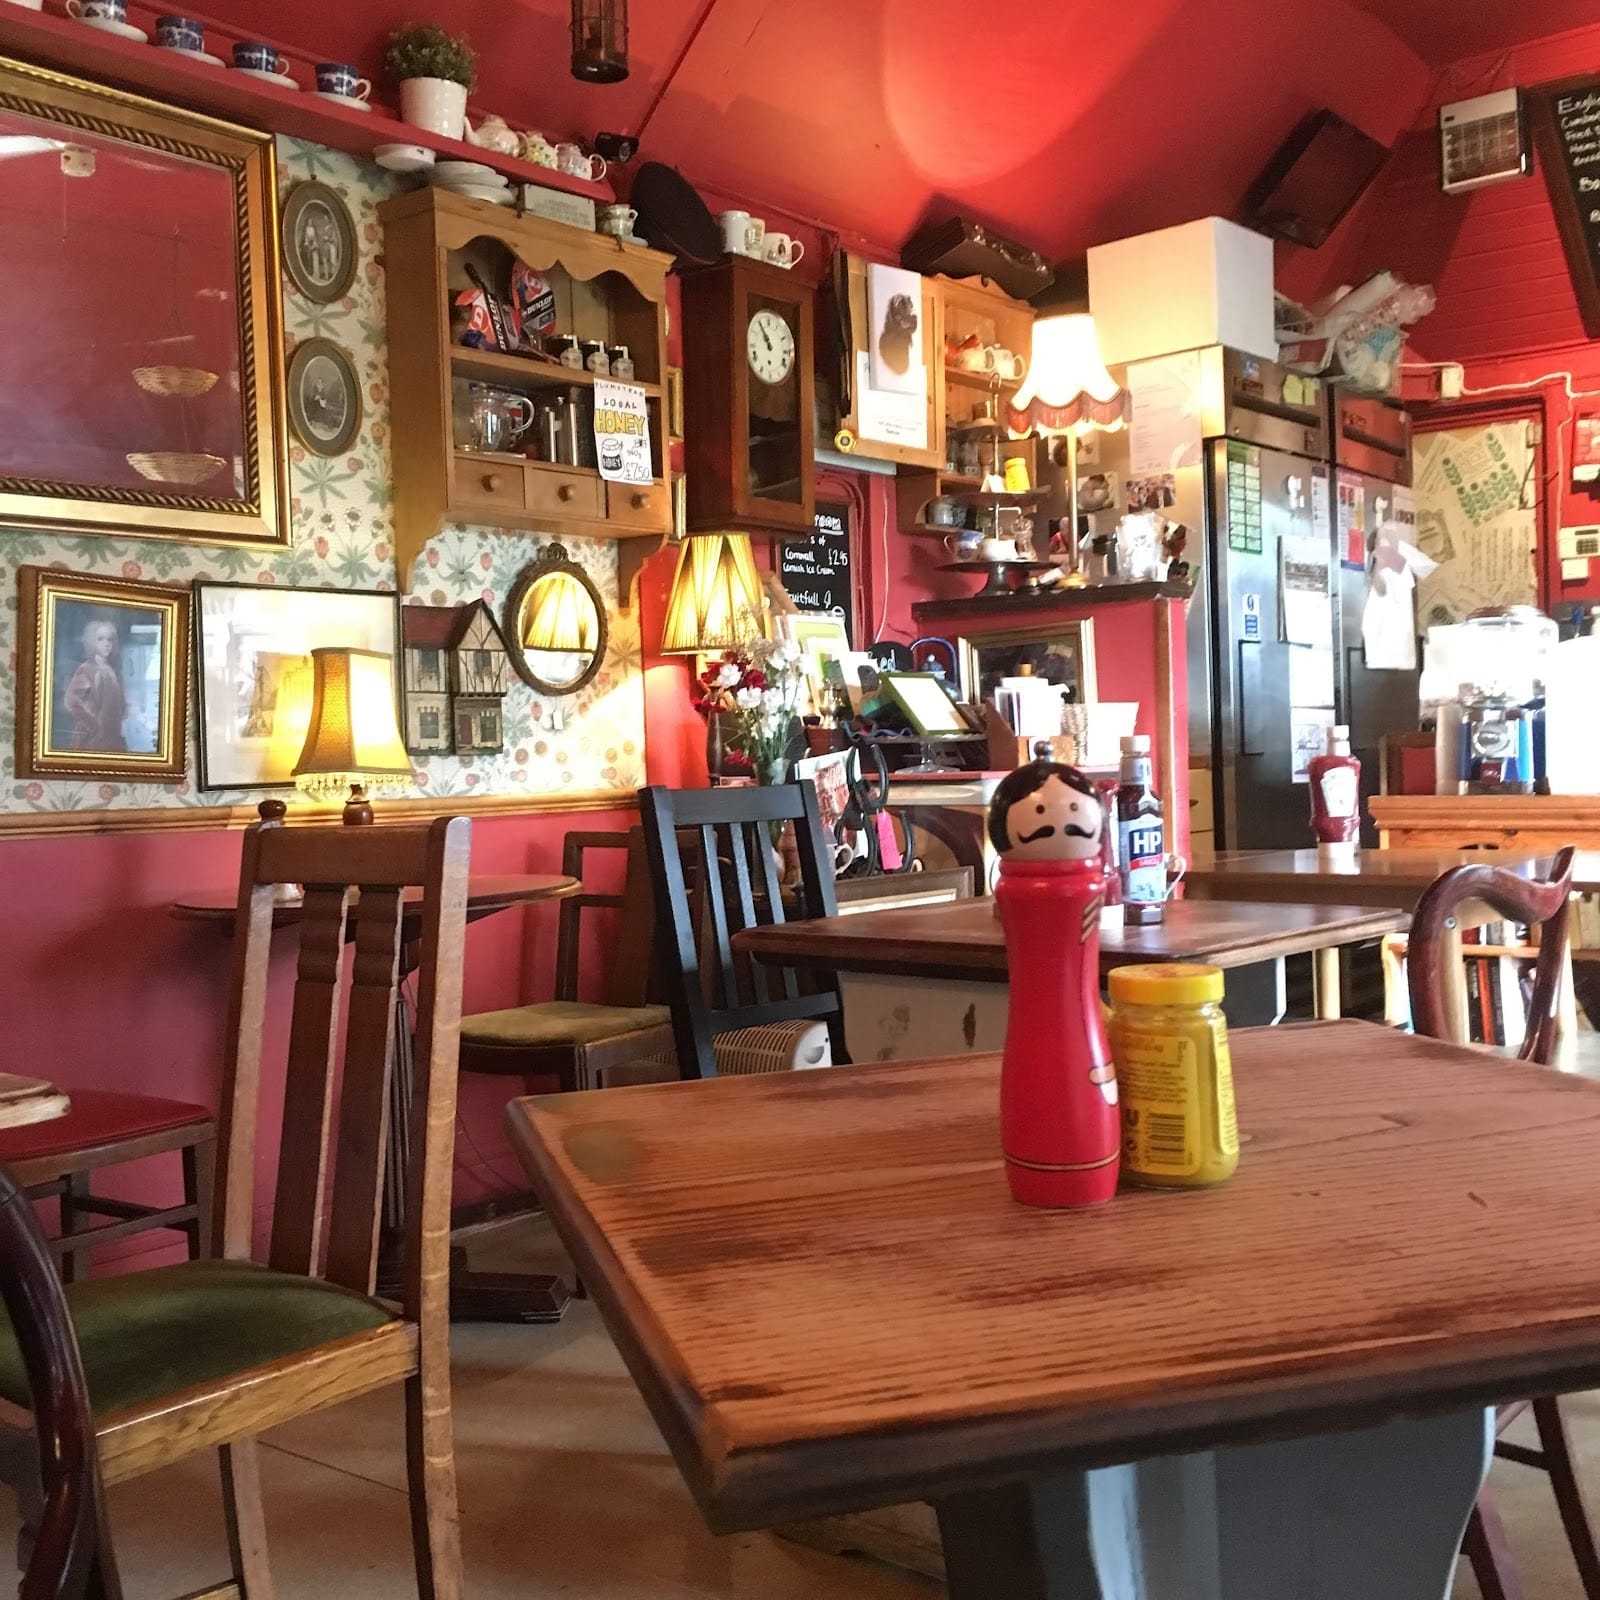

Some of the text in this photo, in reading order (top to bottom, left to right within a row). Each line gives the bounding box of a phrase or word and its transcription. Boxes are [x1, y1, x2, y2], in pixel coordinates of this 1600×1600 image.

[527, 294, 554, 315] DUNLOP
[603, 398, 637, 409] LOCAL
[595, 409, 645, 436] HONEY
[785, 547, 816, 563] Cornwall
[806, 564, 816, 575] Ice
[785, 589, 821, 607] ruitfull
[1133, 831, 1162, 855] HP
